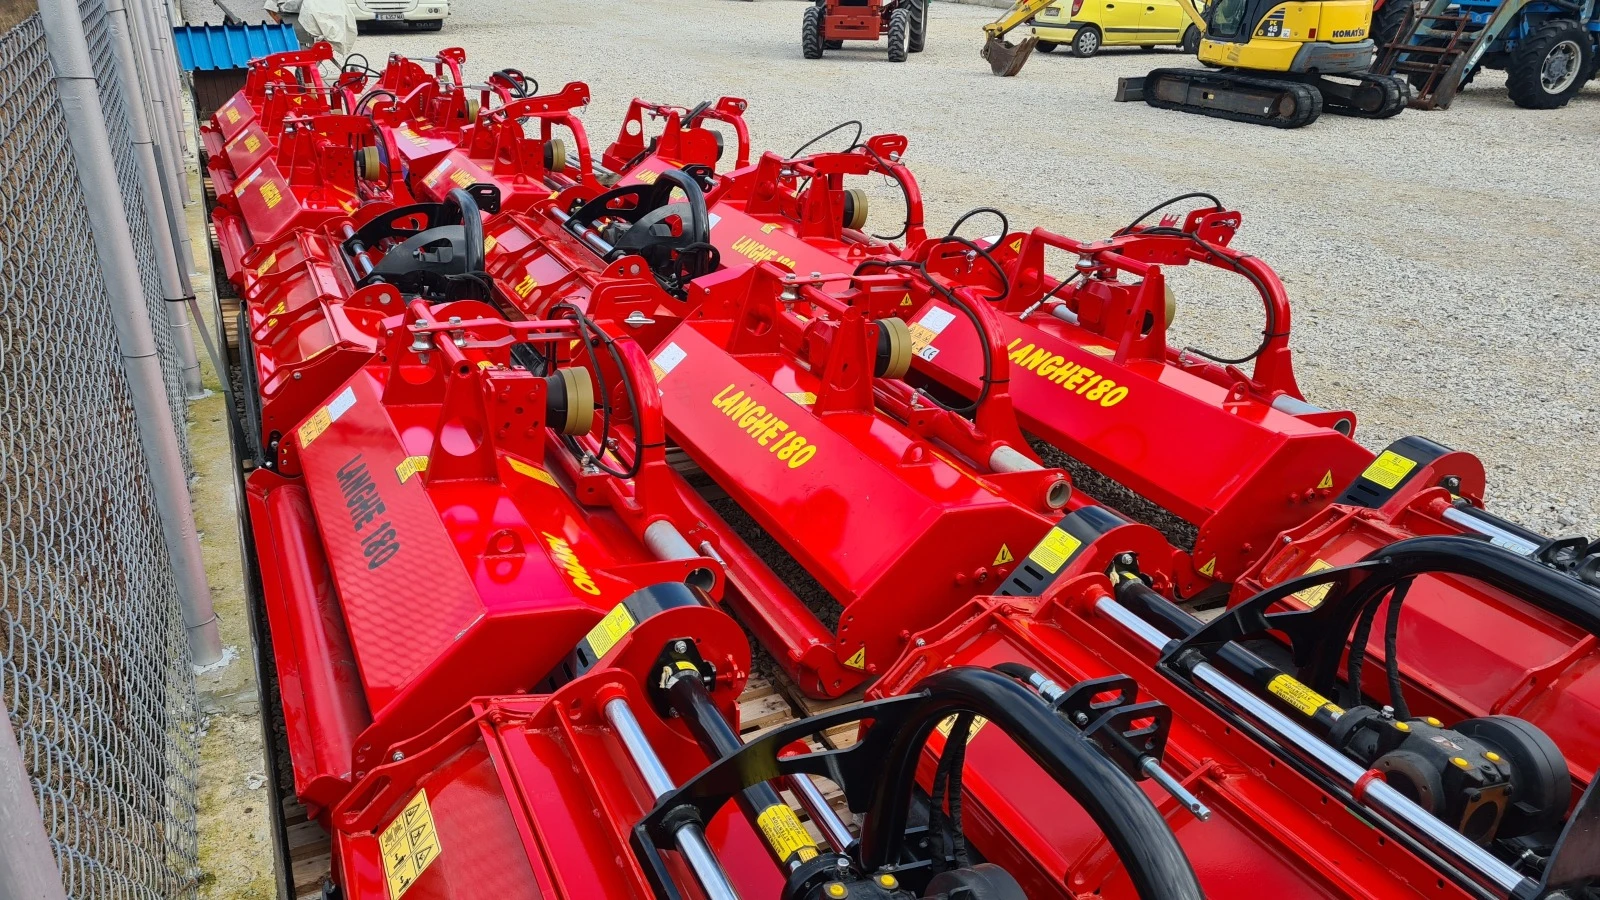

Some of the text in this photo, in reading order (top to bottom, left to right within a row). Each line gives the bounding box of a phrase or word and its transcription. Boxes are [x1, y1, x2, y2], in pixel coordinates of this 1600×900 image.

[1267, 25, 1278, 33] 45
[1332, 27, 1365, 38] KOMATSU
[514, 274, 538, 298] 220
[712, 383, 817, 469] LANGHE 180
[336, 453, 386, 532] LANGHE
[360, 521, 400, 570] 180
